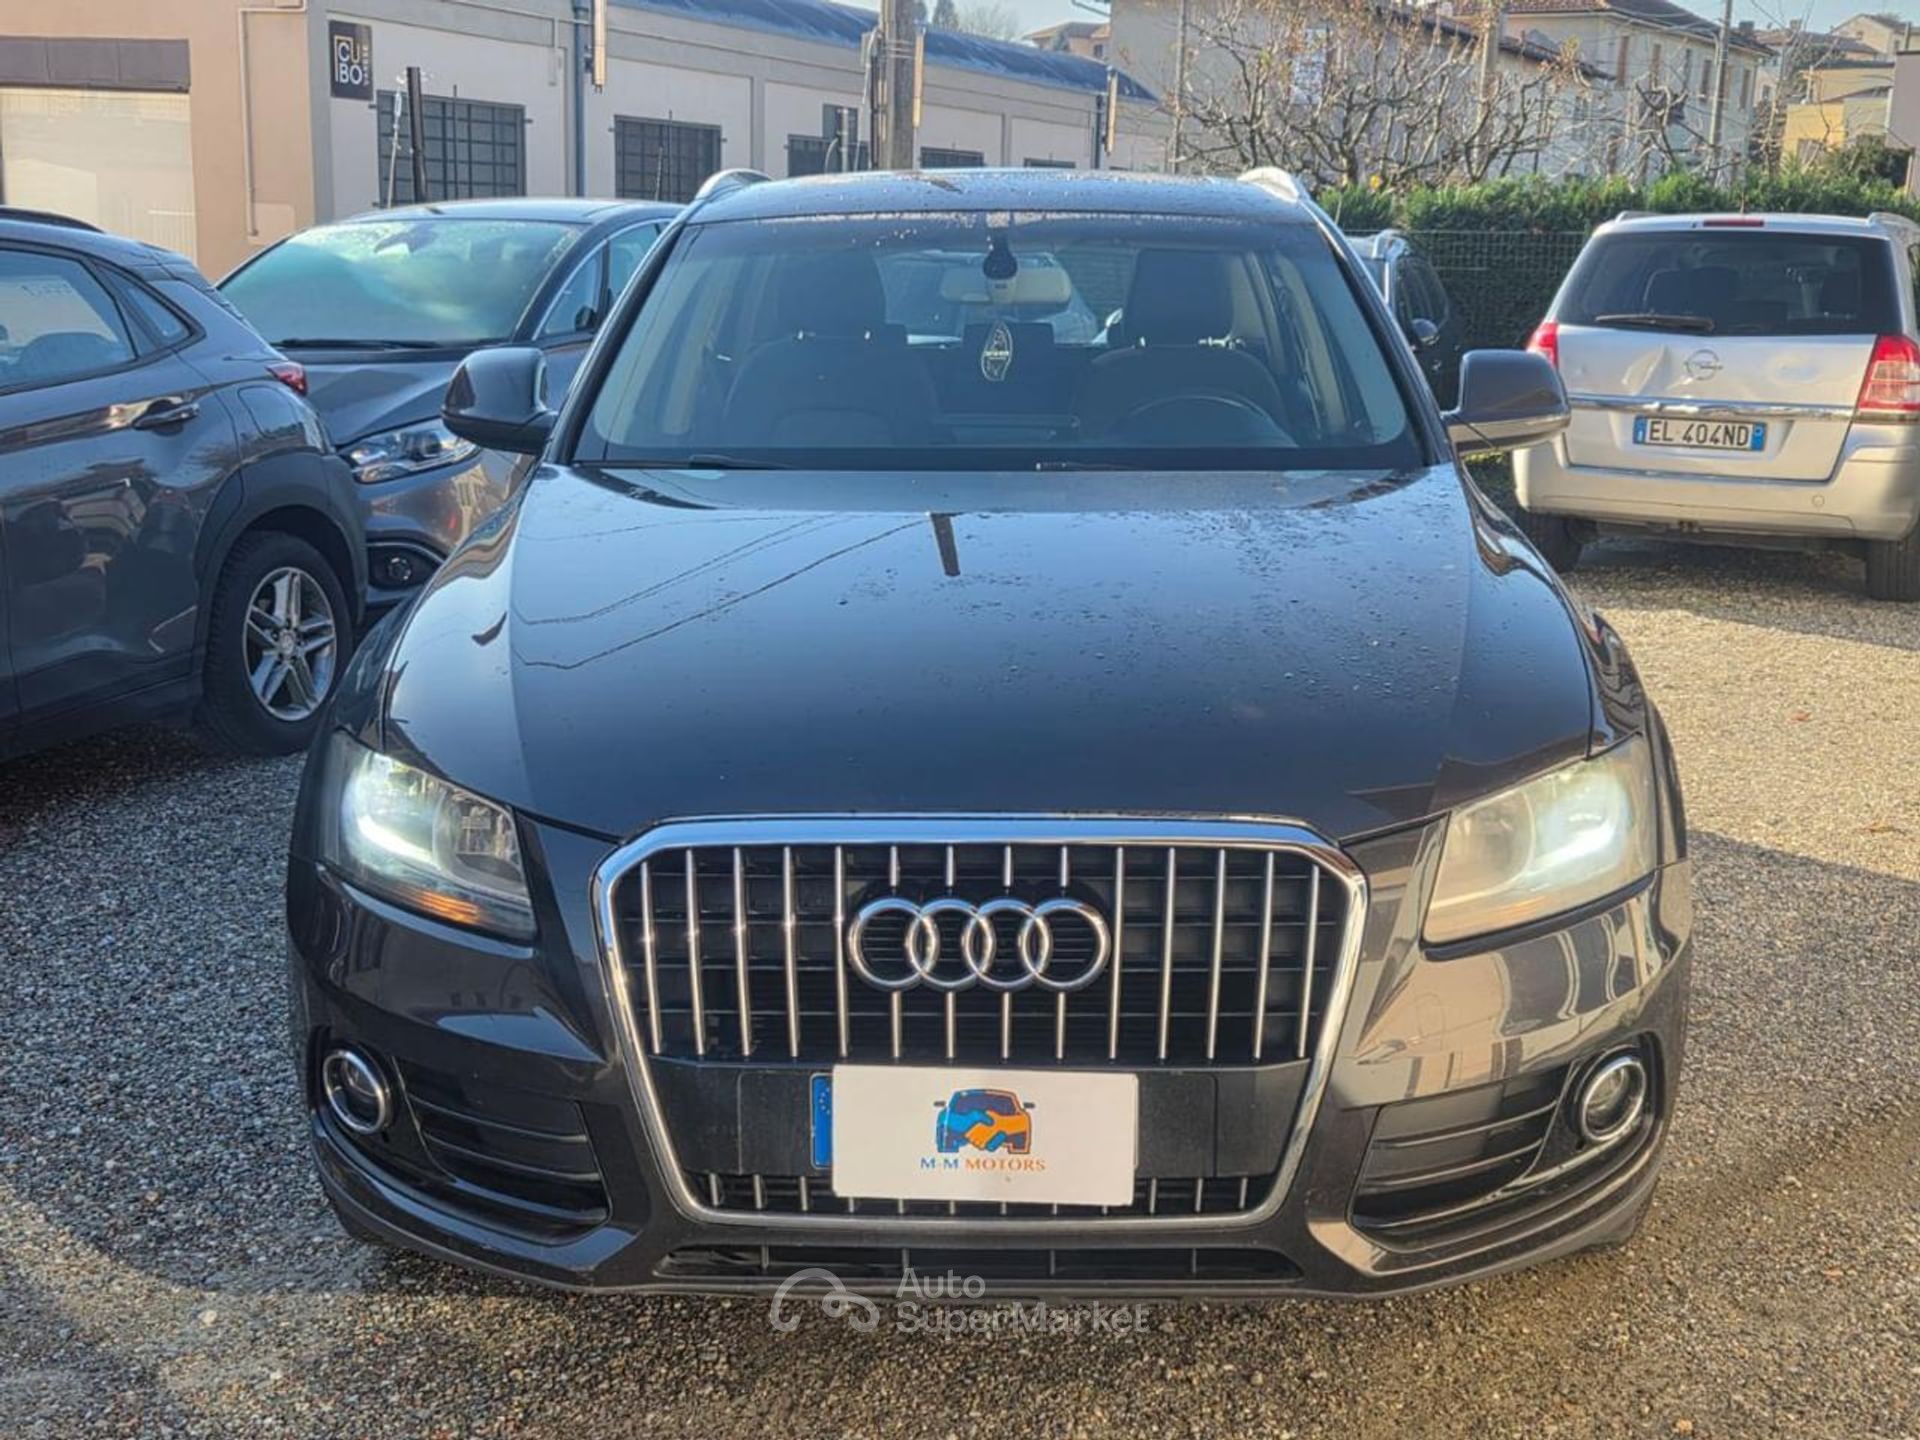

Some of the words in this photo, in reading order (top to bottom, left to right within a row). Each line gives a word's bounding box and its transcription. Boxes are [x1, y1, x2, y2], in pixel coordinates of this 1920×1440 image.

[1649, 421, 1673, 442] EL
[1682, 422, 1750, 446] 404ND
[965, 1158, 1046, 1171] MOTORS
